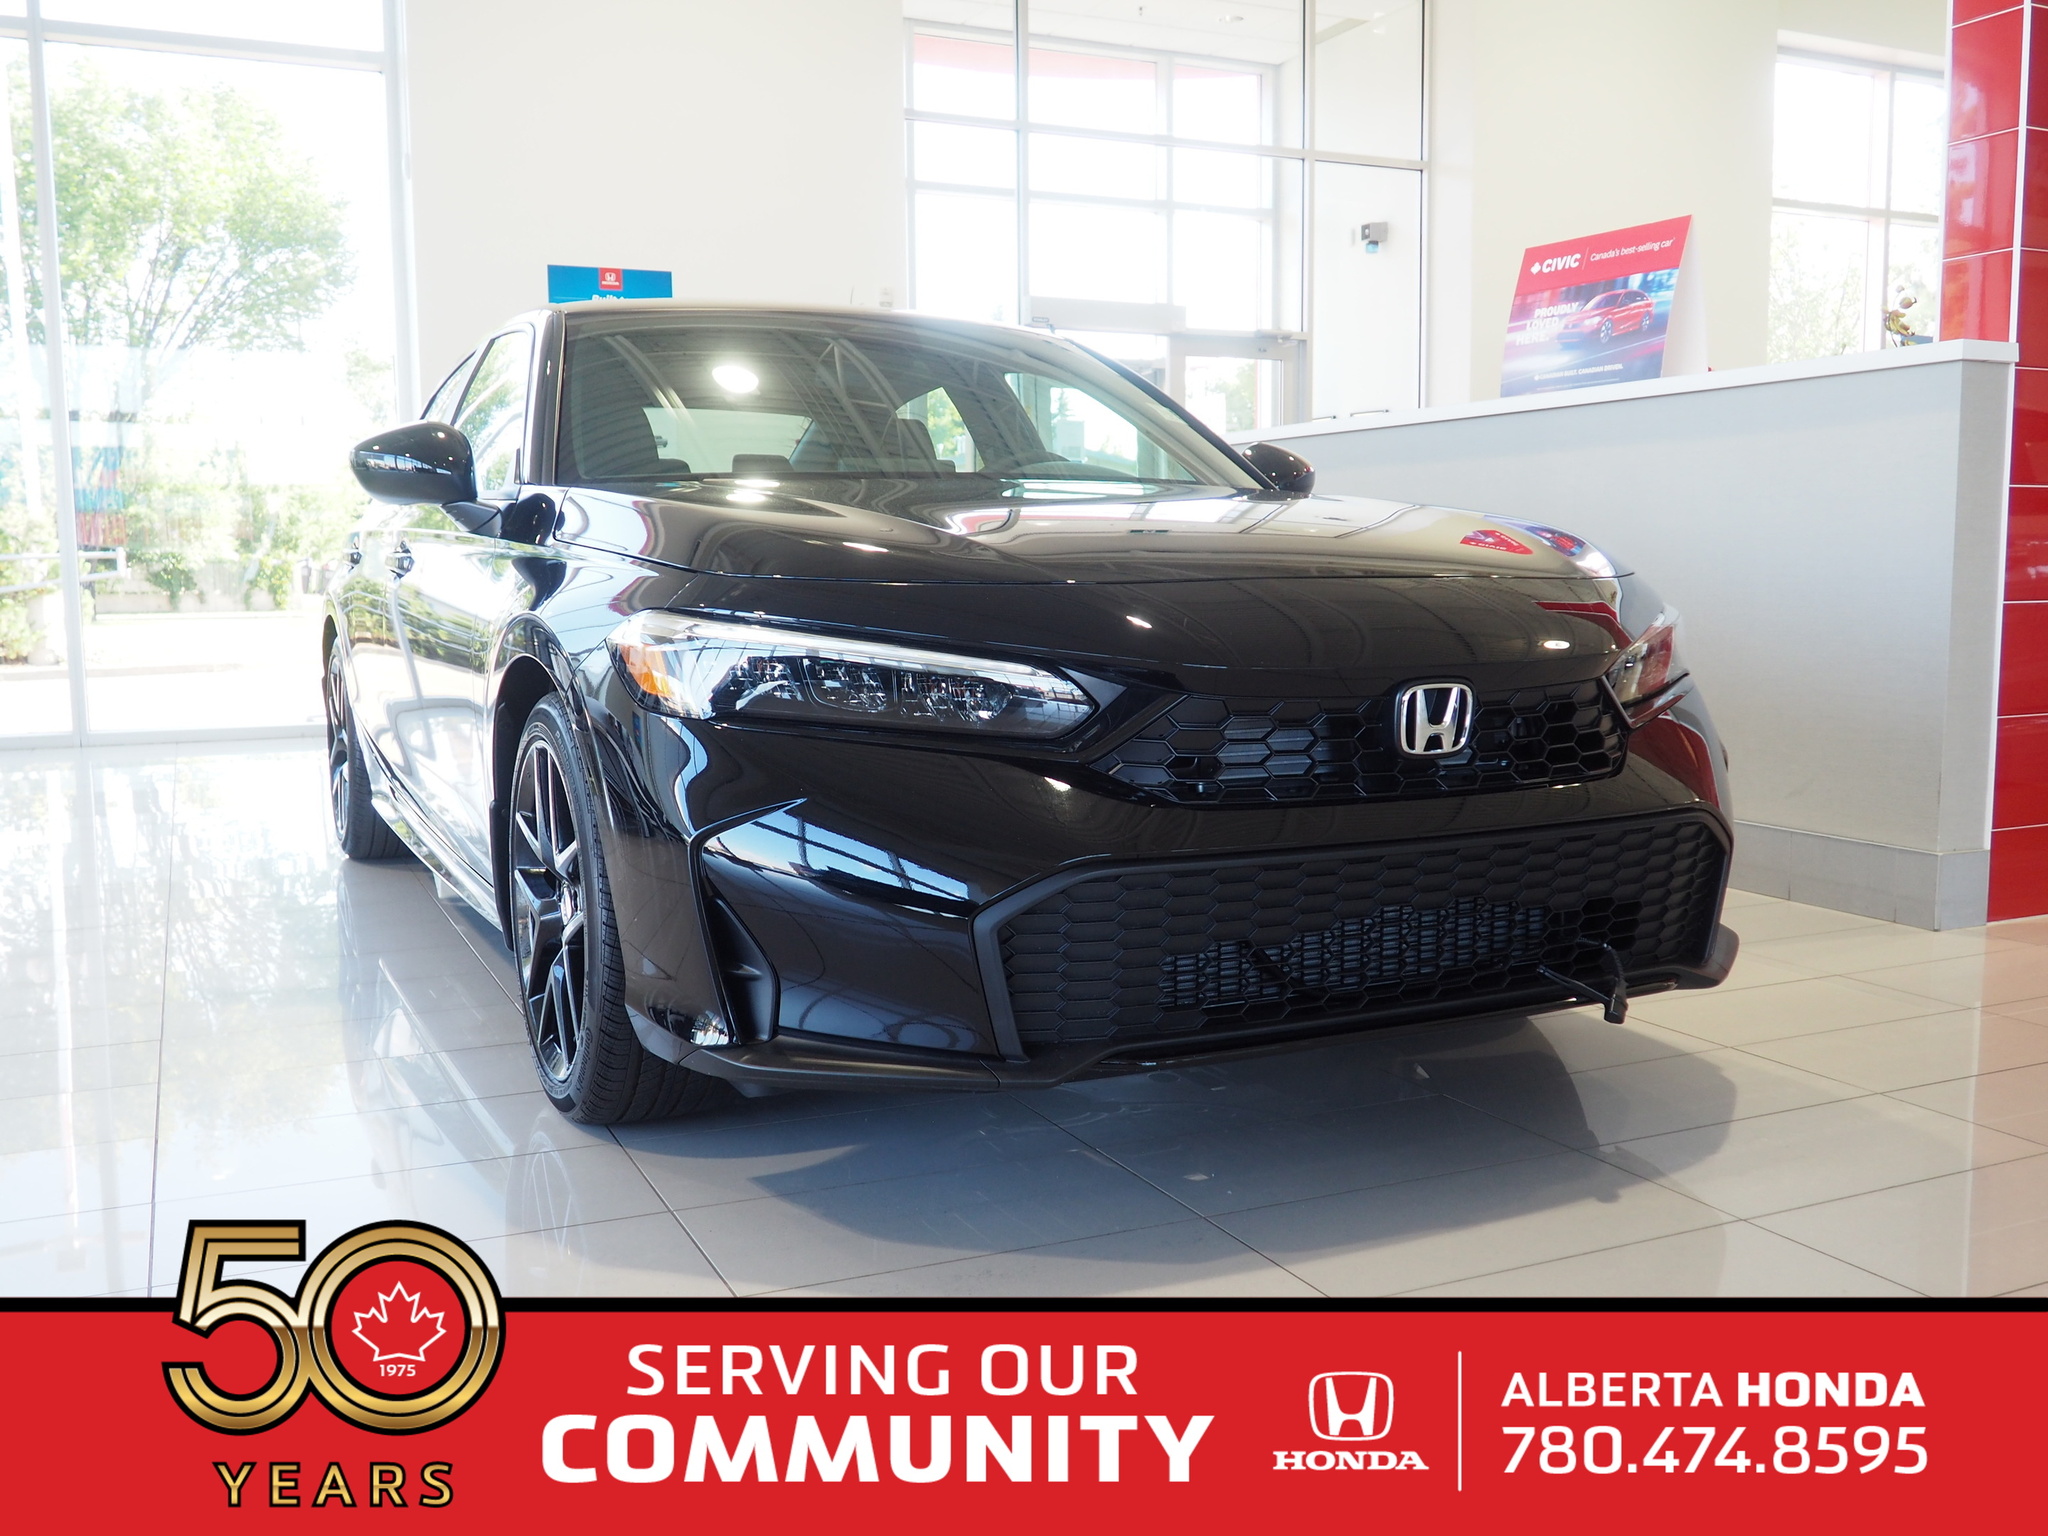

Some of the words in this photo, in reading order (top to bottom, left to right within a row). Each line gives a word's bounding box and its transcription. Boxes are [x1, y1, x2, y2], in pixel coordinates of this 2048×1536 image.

[1541, 253, 1581, 273] CIVIC
[1590, 248, 1620, 262] Canada's
[1620, 241, 1660, 256] best-selling
[1534, 302, 1579, 318] PROUDLY
[1526, 316, 1560, 331] LOVED
[1515, 332, 1549, 346] HERE.
